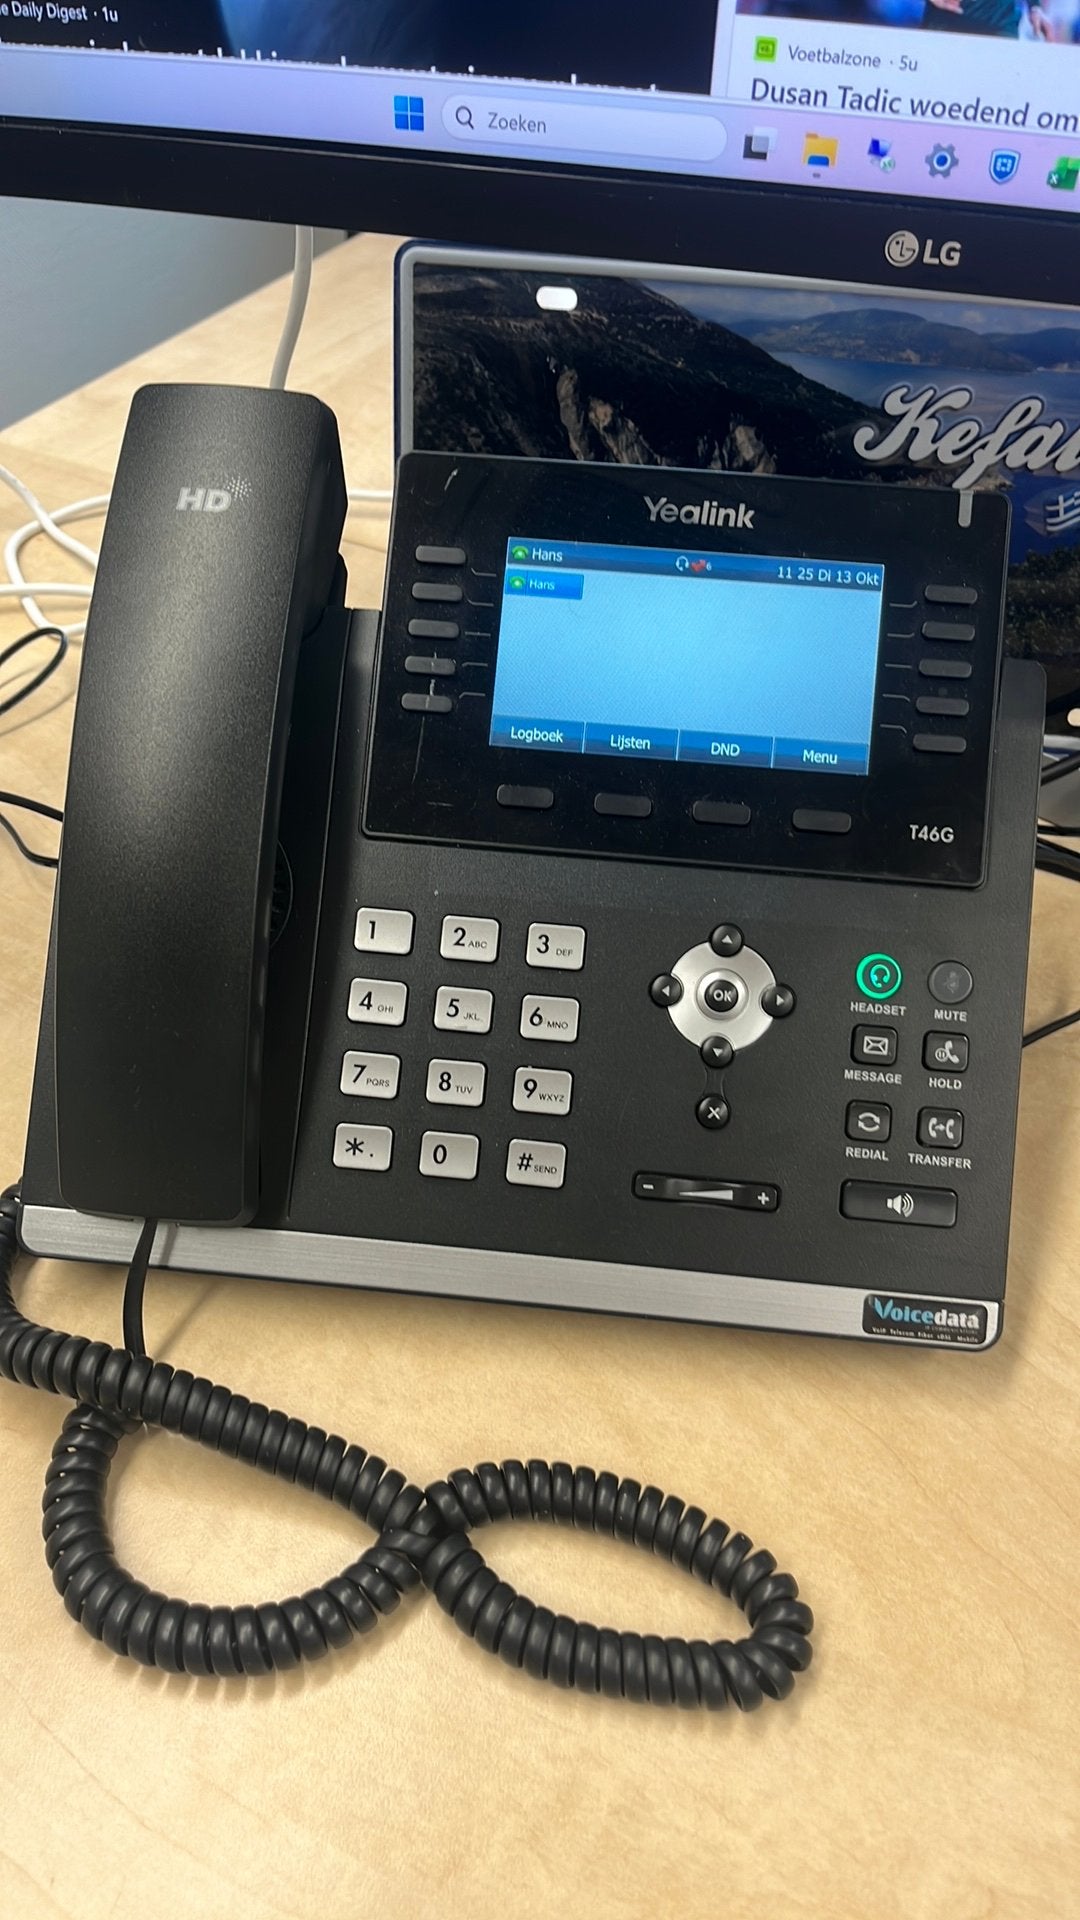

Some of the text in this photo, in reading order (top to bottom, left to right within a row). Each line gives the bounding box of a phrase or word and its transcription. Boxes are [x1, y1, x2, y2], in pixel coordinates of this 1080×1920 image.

[11, 1, 42, 22] Daily
[46, 2, 88, 24] Digest
[102, 6, 118, 22] 1u
[788, 44, 881, 68] Voetbalzone
[899, 55, 918, 71] 5u
[751, 77, 1079, 132] Dusan Tadic woedend om
[488, 112, 546, 133] Zoeken
[923, 239, 962, 267] LG
[176, 487, 232, 512] HD
[643, 496, 755, 529] Yealink
[532, 547, 563, 562] Hans
[529, 579, 555, 590] Hans
[778, 566, 792, 579] 11
[797, 567, 814, 580] 25
[836, 570, 851, 583] 13
[856, 572, 880, 586] Okt
[510, 726, 563, 744] Logboek
[610, 734, 651, 751] Lijsten
[711, 742, 740, 757] DND
[803, 749, 837, 765] Menu
[909, 824, 954, 843] T46G
[368, 920, 376, 939] 1
[453, 927, 488, 949] 2 ABC
[536, 934, 574, 957] 3 DEF
[359, 991, 394, 1013] 4 GHI
[713, 988, 732, 1003] OK
[446, 998, 480, 1021] 5 JKL
[529, 1007, 569, 1030] 6 MNO
[850, 1002, 907, 1017] HEADSET
[934, 1009, 968, 1022] MUTE
[353, 1064, 390, 1087] 7 PQRS
[438, 1072, 473, 1094] 8 TUV
[844, 1069, 902, 1085] MESSAGE
[928, 1077, 962, 1090] HOLD
[523, 1079, 565, 1102] 9 WXYZ
[433, 1144, 447, 1164] 0
[516, 1153, 557, 1174] # SEND
[845, 1147, 889, 1162] REDIAL
[908, 1153, 972, 1170] TRANSFER
[874, 1297, 980, 1329] Voicedata
